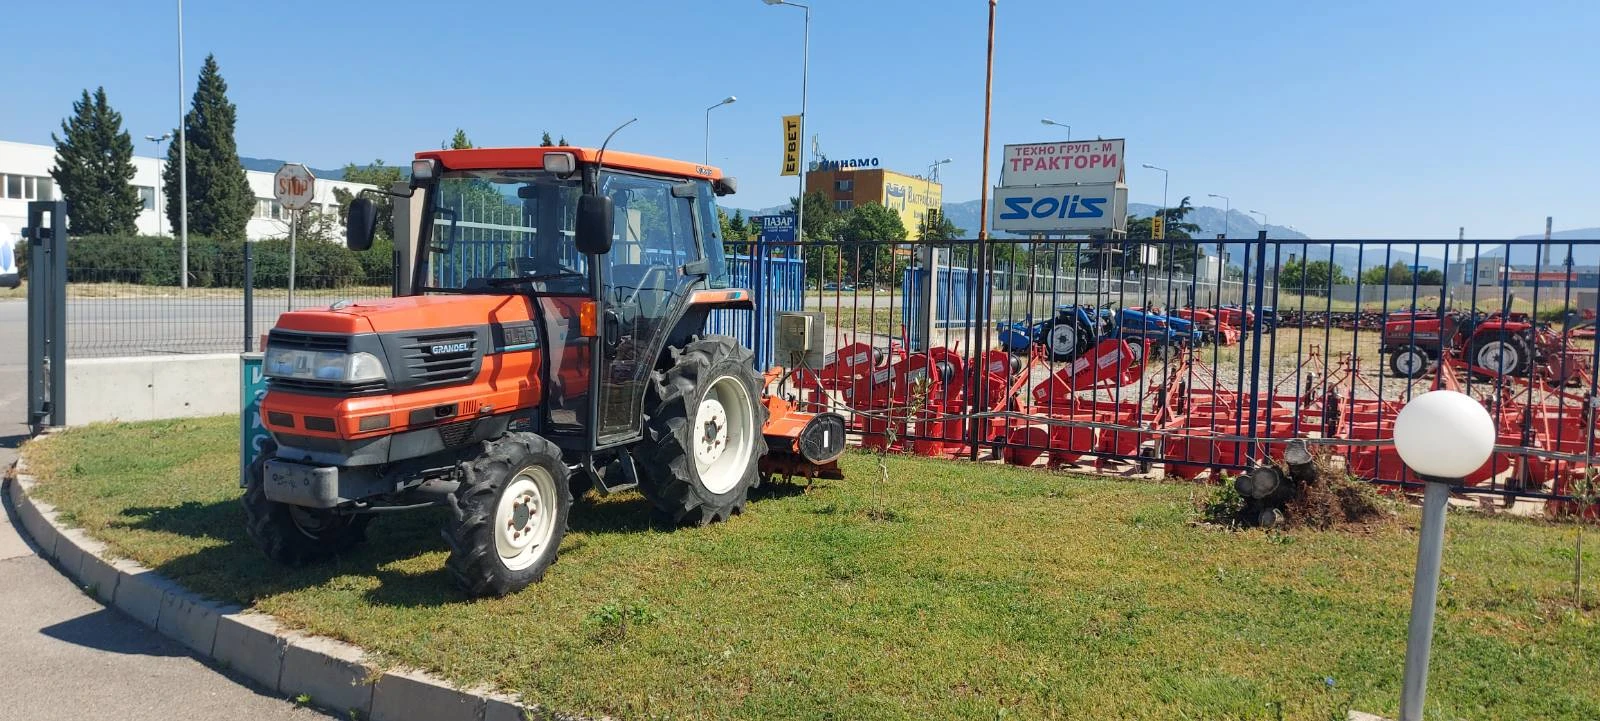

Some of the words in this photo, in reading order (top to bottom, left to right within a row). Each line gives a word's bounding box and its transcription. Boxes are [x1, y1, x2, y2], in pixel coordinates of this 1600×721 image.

[786, 120, 797, 172] EFBET
[1015, 145, 1055, 157] ТЕХНО
[1060, 143, 1090, 155] ГРУП
[1102, 142, 1112, 153] М
[1009, 153, 1117, 172] ТРАКТОРИ
[279, 176, 308, 197] STOP
[764, 217, 793, 227] ПАЗАР
[432, 342, 469, 355] GRANDEL
